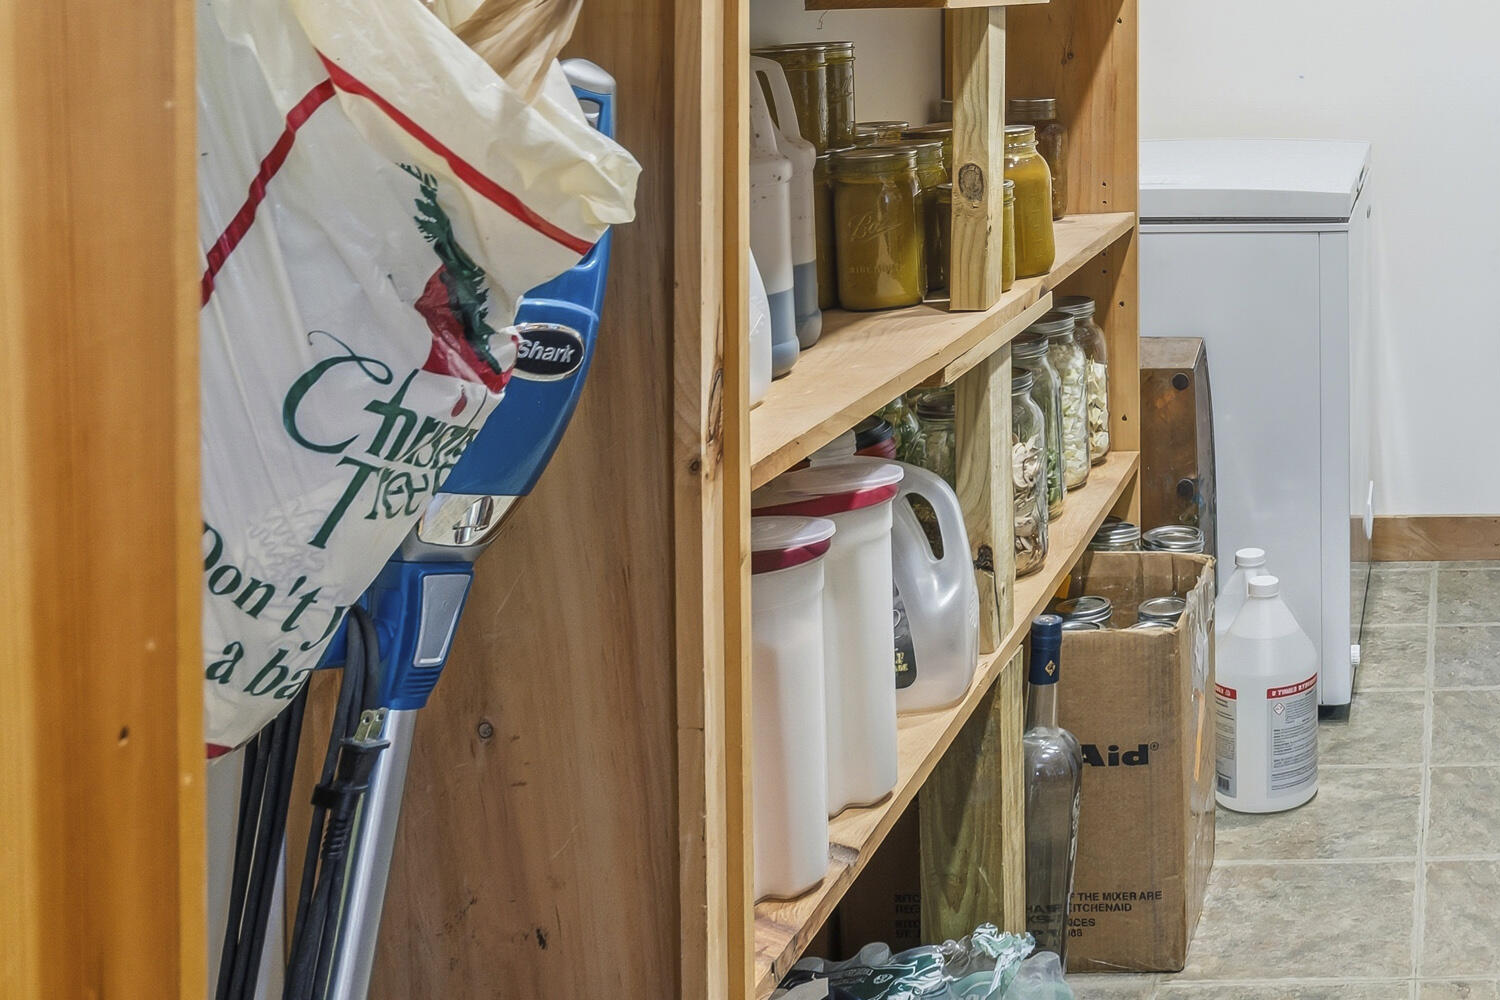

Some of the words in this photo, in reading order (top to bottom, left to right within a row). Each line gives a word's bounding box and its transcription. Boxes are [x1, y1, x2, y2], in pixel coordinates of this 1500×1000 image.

[517, 339, 576, 363] Shark
[206, 641, 244, 685] a
[1078, 892, 1100, 902] THE
[1102, 891, 1137, 902] MIXER
[1139, 890, 1163, 901] ARE
